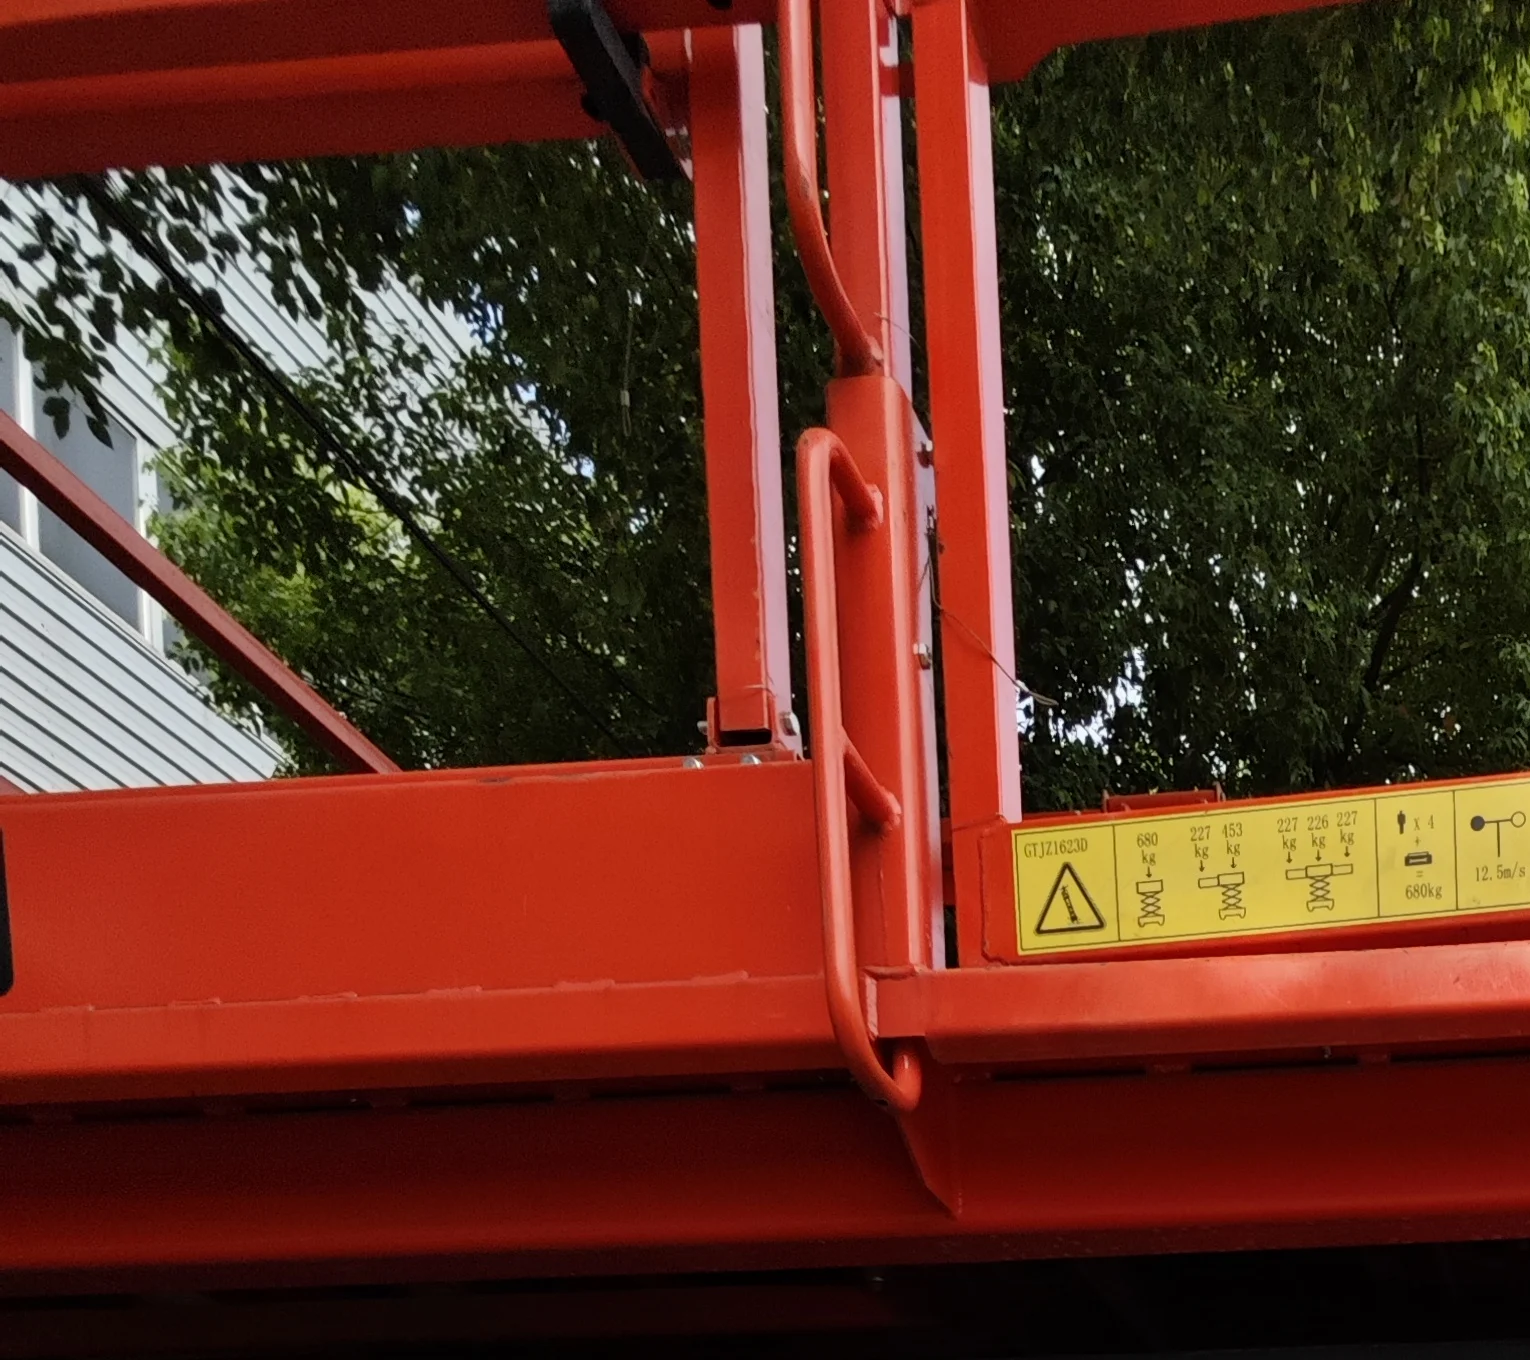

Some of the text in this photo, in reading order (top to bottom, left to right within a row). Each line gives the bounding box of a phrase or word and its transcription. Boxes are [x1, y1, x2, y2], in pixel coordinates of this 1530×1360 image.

[1277, 811, 1358, 833] 227 226 227
[1427, 814, 1435, 829] 4
[1137, 832, 1158, 848] 680
[1190, 822, 1243, 841] 227 453
[1282, 829, 1354, 851] kg kg kg
[1024, 837, 1088, 859] GTJZ1623D
[1194, 840, 1241, 860] kg kg
[1141, 850, 1156, 866] kg
[1475, 861, 1526, 882] 12.5m/s
[1405, 882, 1443, 900] 680kg
